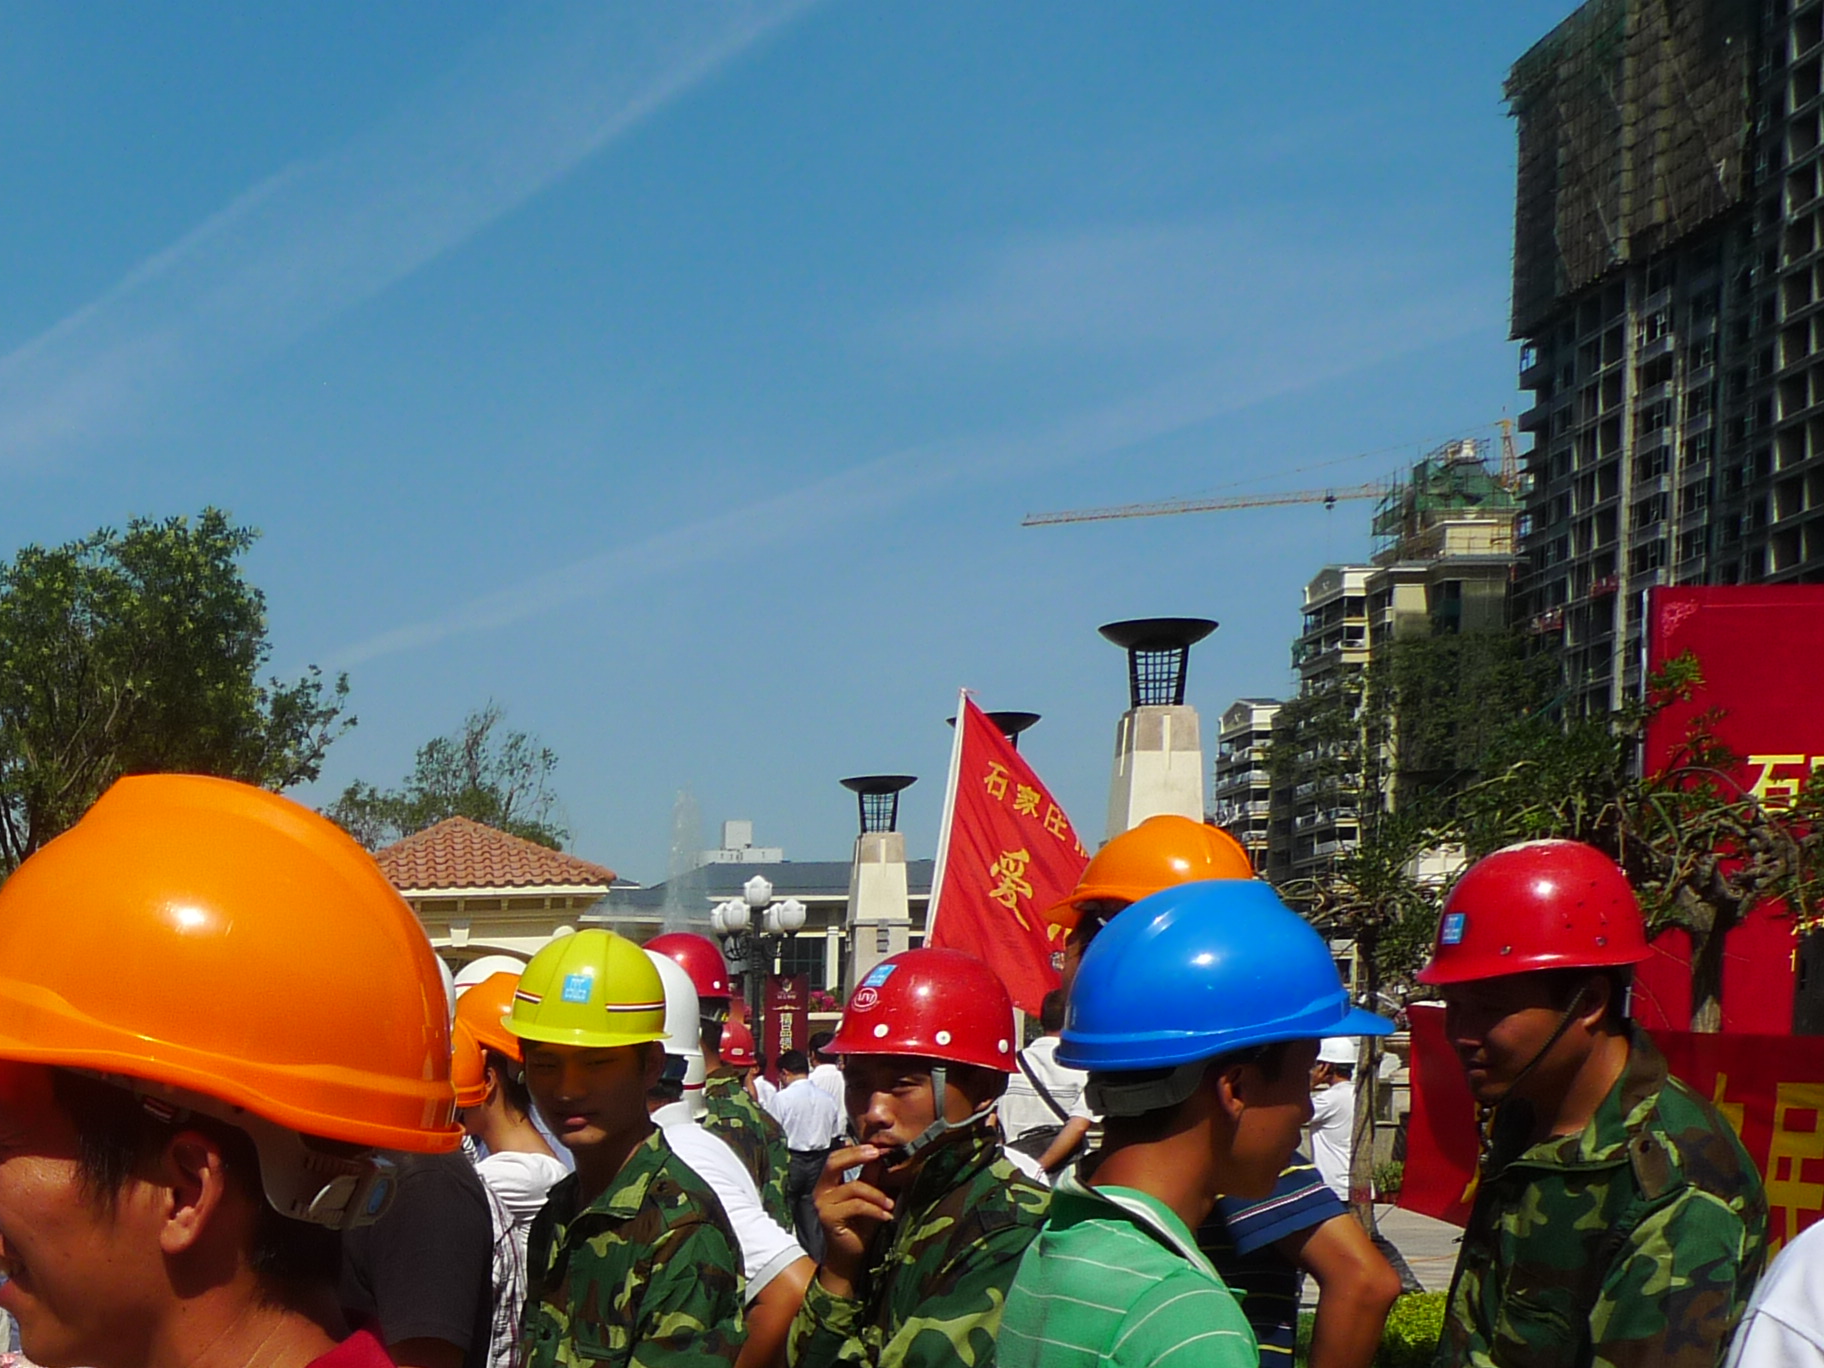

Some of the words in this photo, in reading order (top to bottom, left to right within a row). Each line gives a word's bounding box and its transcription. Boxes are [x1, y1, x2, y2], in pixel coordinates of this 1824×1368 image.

[983, 760, 1088, 858] 石家庄
[1747, 754, 1824, 813] 石
